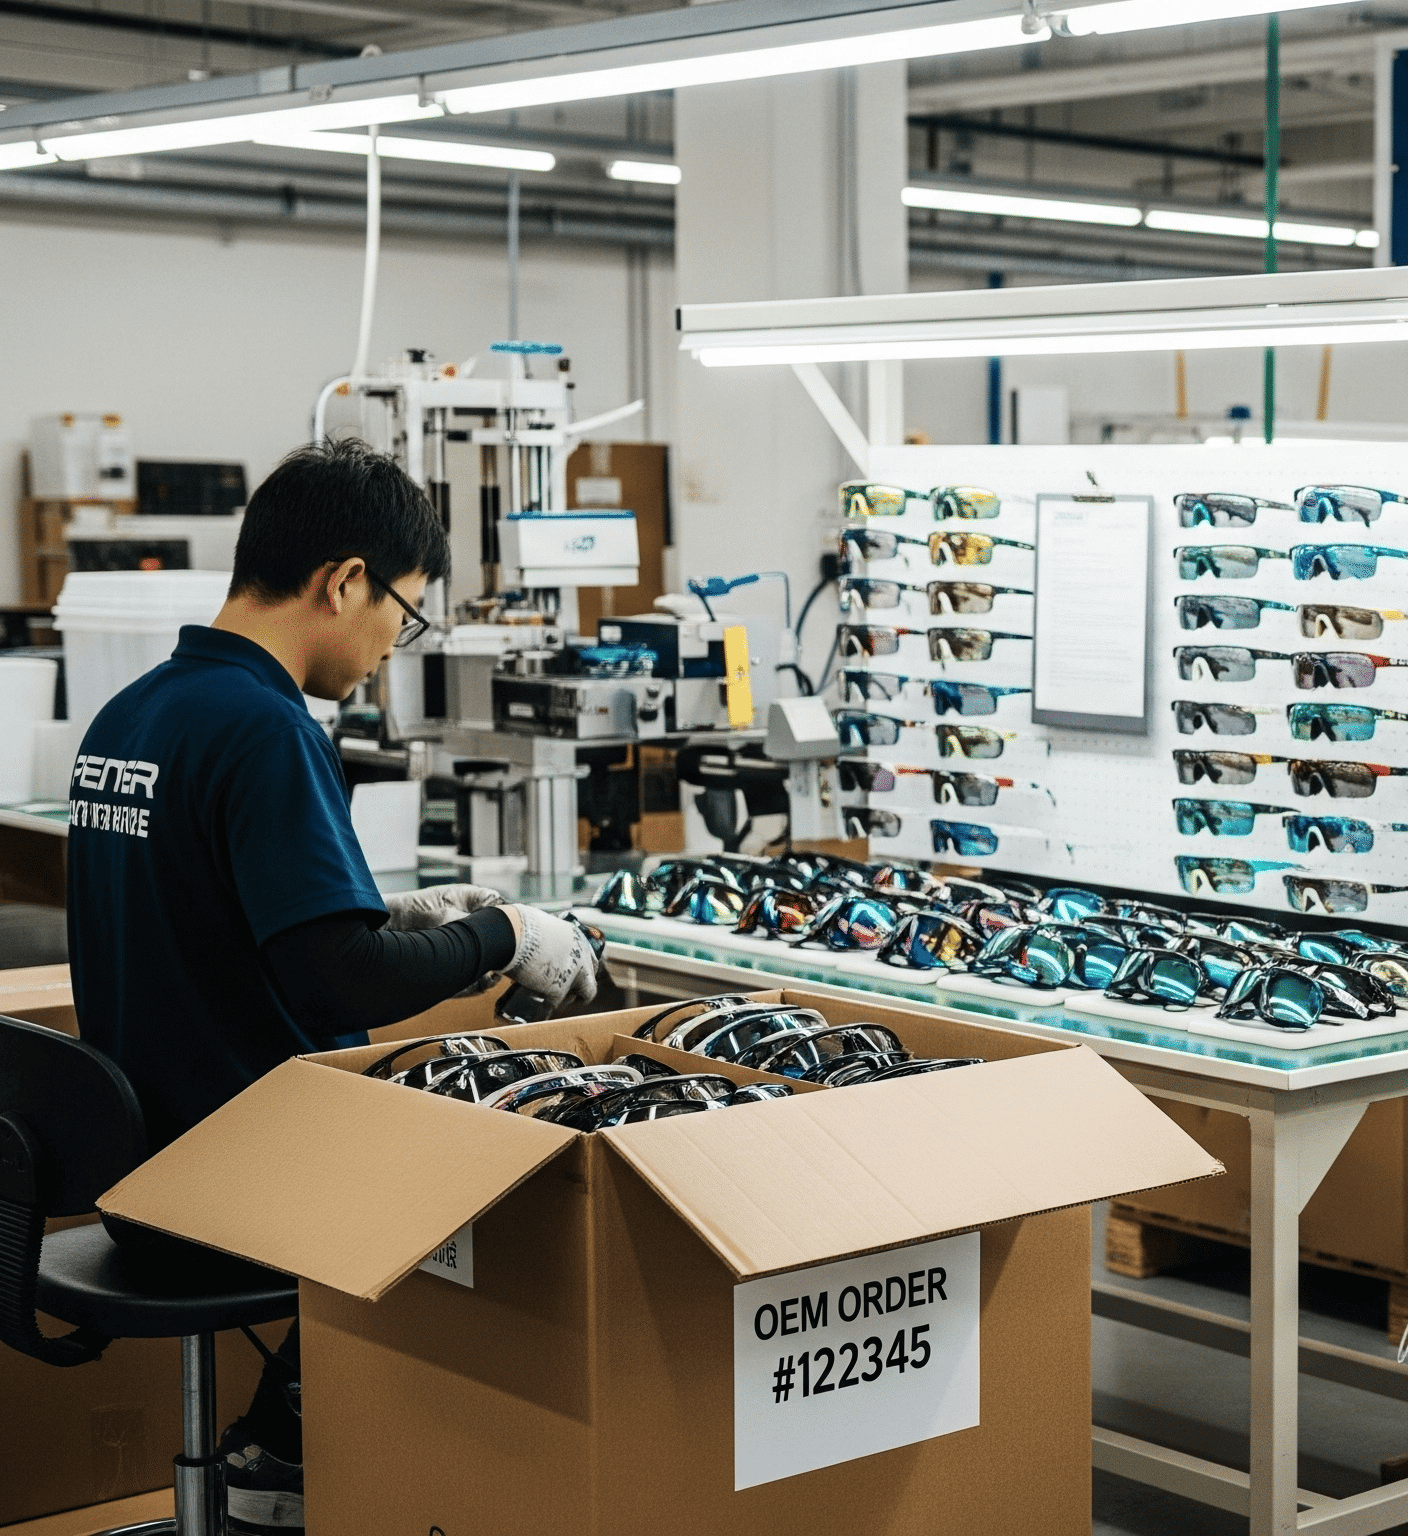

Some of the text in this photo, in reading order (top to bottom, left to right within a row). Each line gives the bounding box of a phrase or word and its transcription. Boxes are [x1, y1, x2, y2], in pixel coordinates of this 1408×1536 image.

[752, 1265, 949, 1342] OEM ORDER
[771, 1322, 932, 1405] #122345
